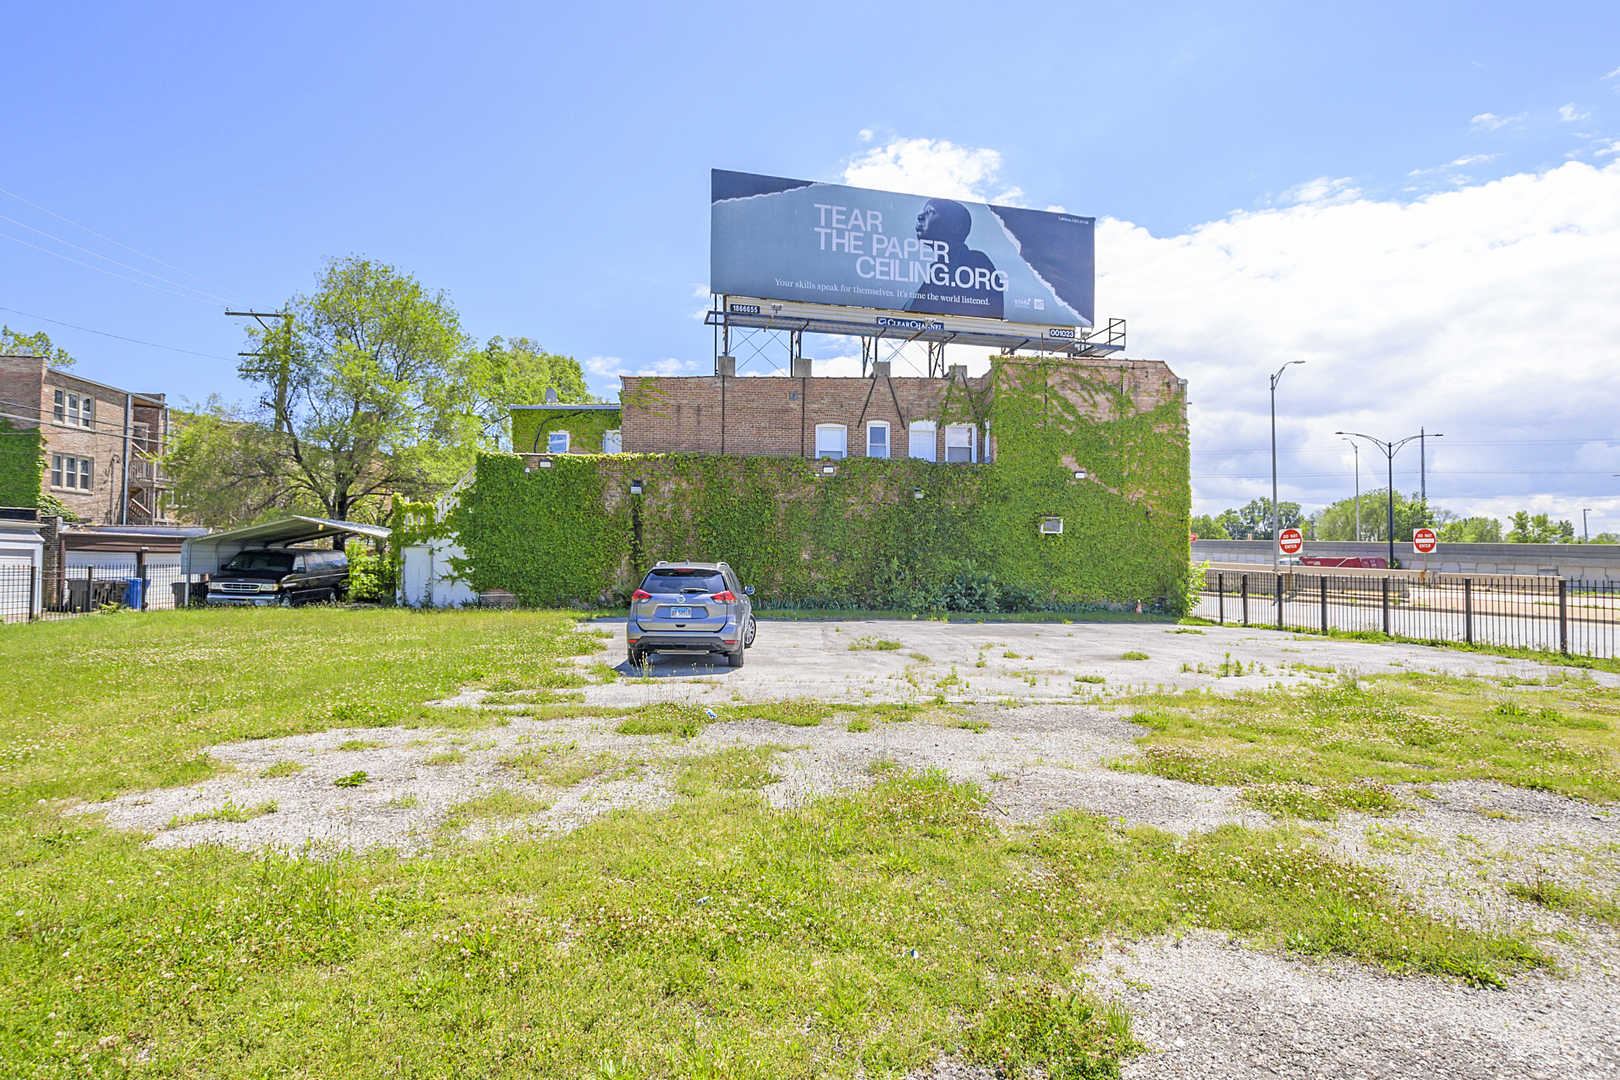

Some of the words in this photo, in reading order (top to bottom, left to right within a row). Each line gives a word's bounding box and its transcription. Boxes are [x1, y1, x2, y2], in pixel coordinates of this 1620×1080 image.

[814, 203, 883, 233] TEAR
[814, 227, 864, 255] THE
[872, 234, 950, 264] PAPER
[855, 255, 1010, 293] CEILING.ORG
[775, 277, 794, 287] Your
[795, 279, 816, 290] skills
[817, 283, 839, 292] speak
[840, 284, 852, 293] for
[853, 286, 895, 297] themselves.
[909, 290, 926, 300] time
[927, 292, 939, 301] the
[939, 294, 961, 304] world
[961, 295, 990, 306] listened.
[1050, 329, 1074, 338] 001023
